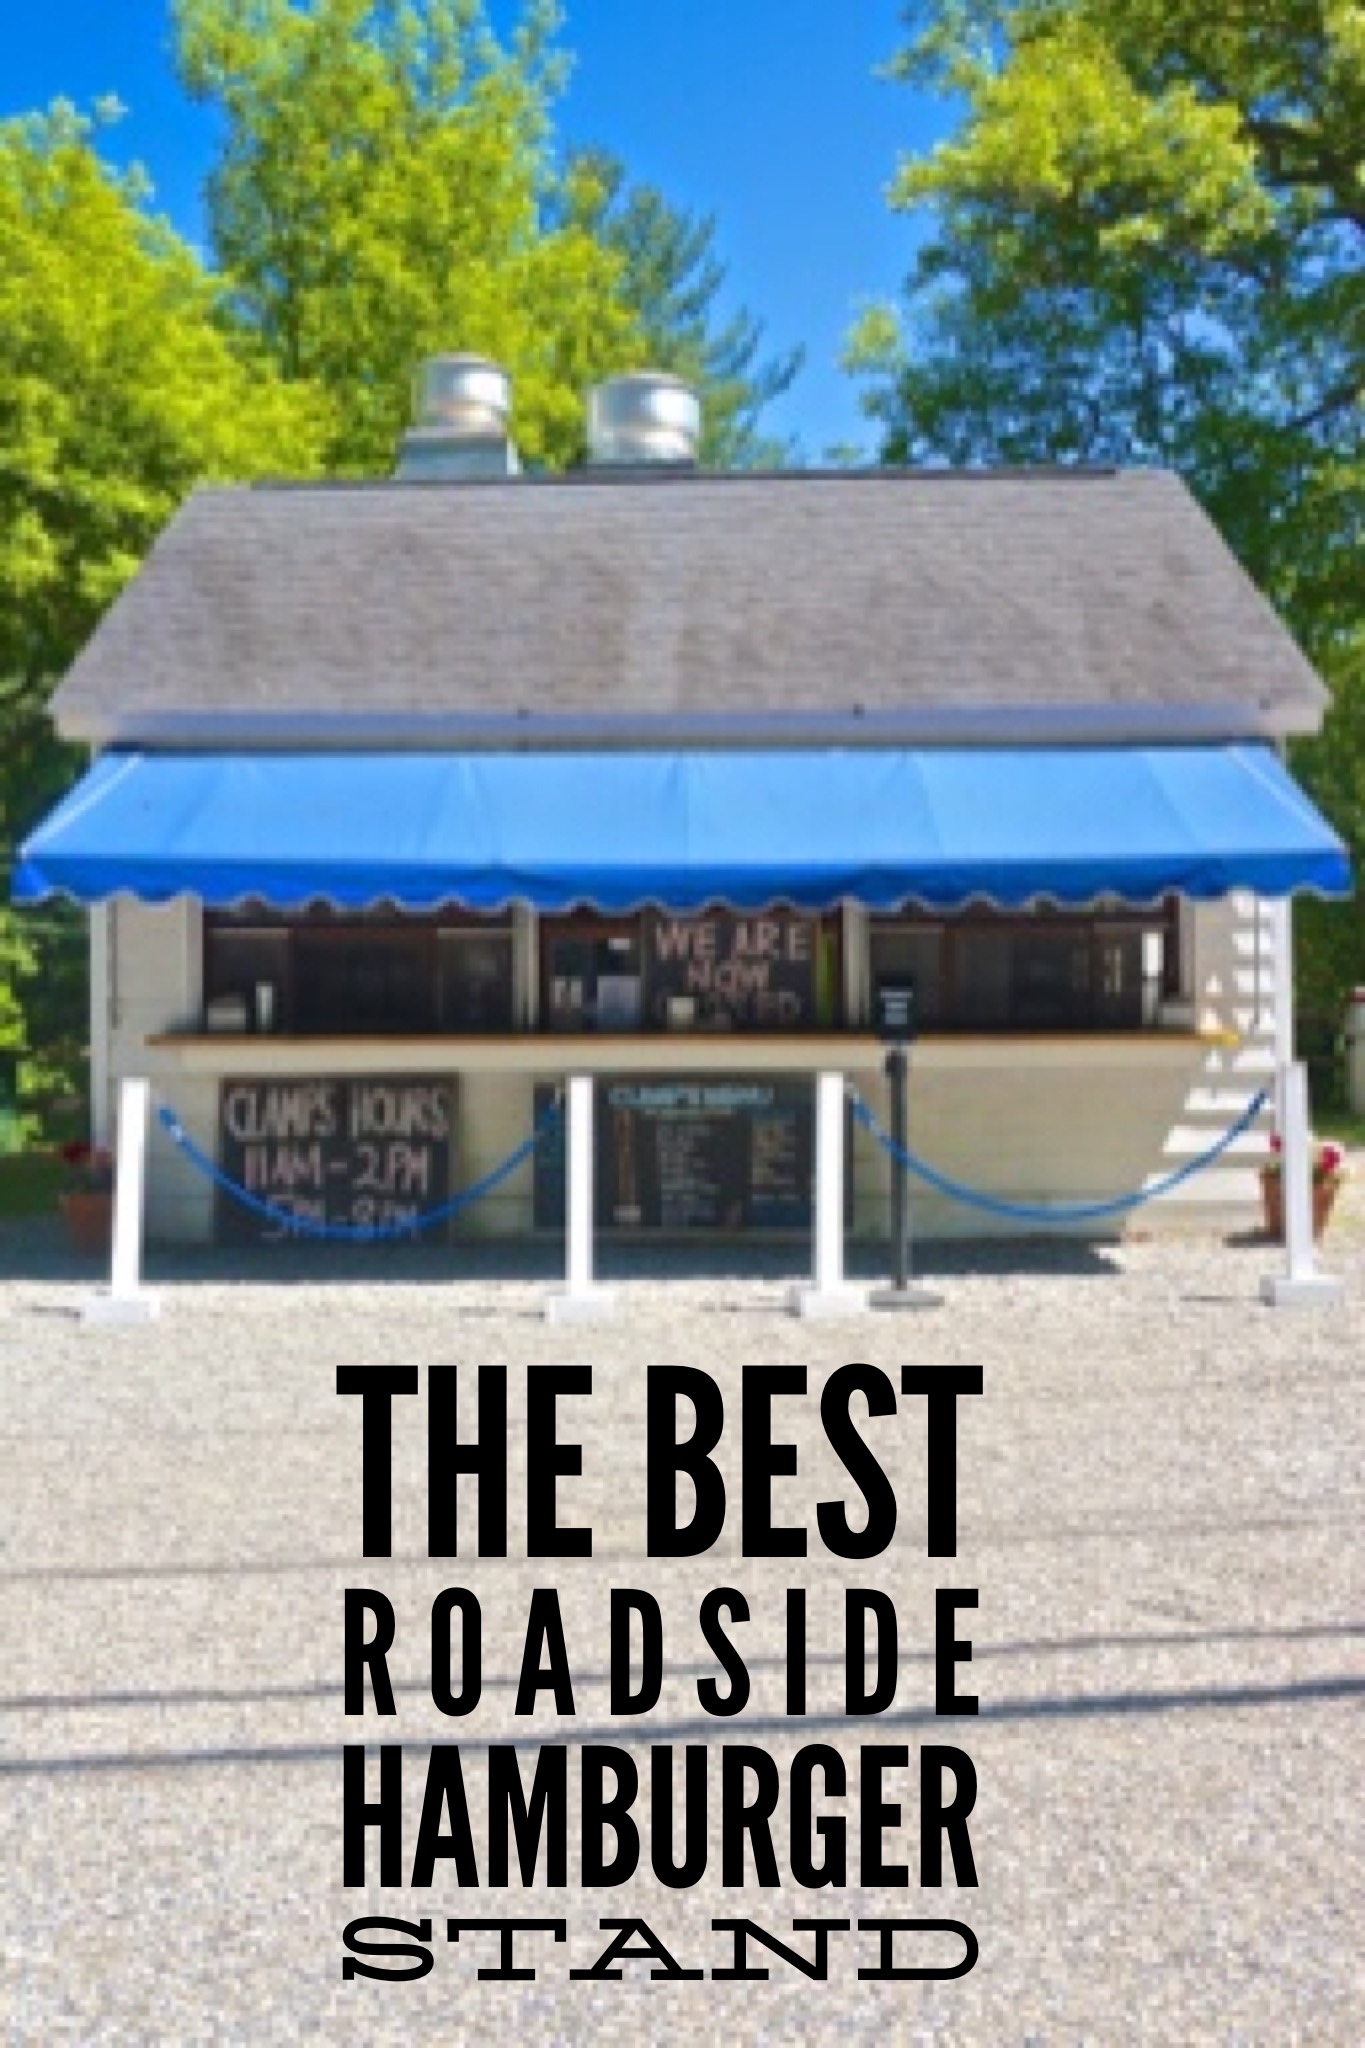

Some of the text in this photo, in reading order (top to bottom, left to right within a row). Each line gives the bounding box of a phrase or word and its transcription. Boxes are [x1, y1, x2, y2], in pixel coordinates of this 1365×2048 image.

[655, 920, 810, 961] WE ARE
[687, 957, 770, 996] NOW
[352, 1084, 450, 1141] HOURS
